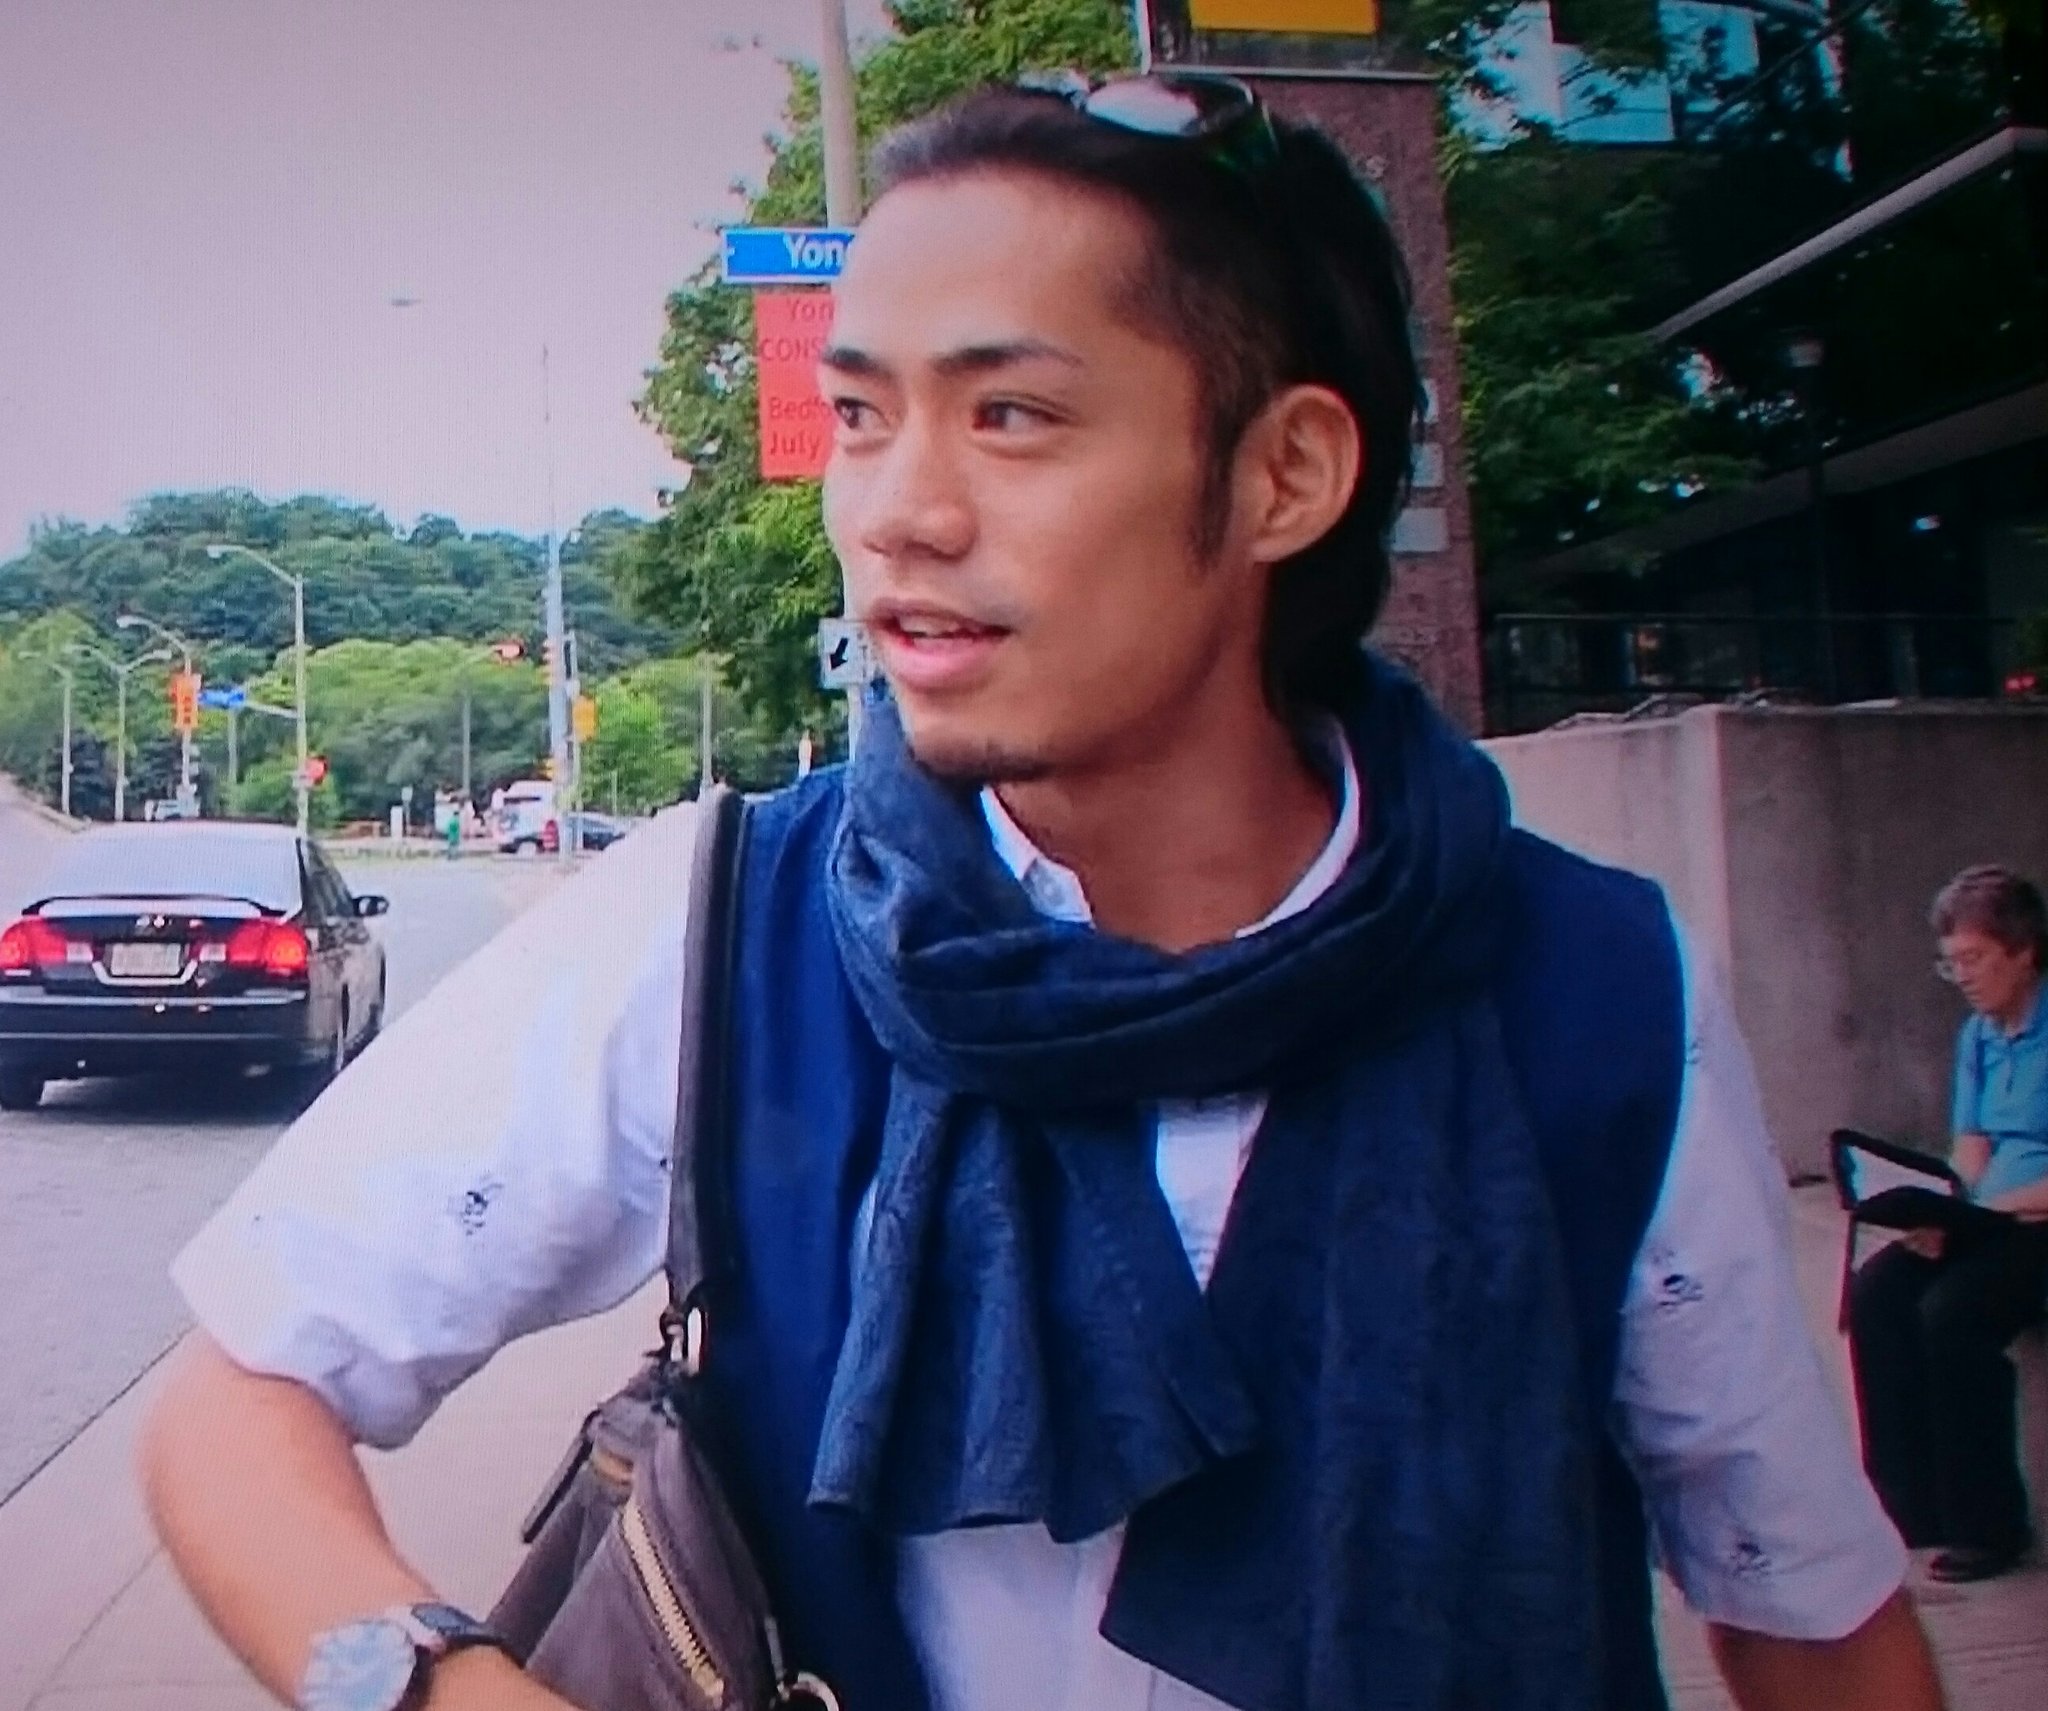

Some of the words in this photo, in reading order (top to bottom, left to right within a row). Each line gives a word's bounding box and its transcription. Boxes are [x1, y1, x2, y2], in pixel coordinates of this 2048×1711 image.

[783, 233, 844, 269] Yon
[786, 300, 835, 321] Yon
[770, 431, 821, 461] July
